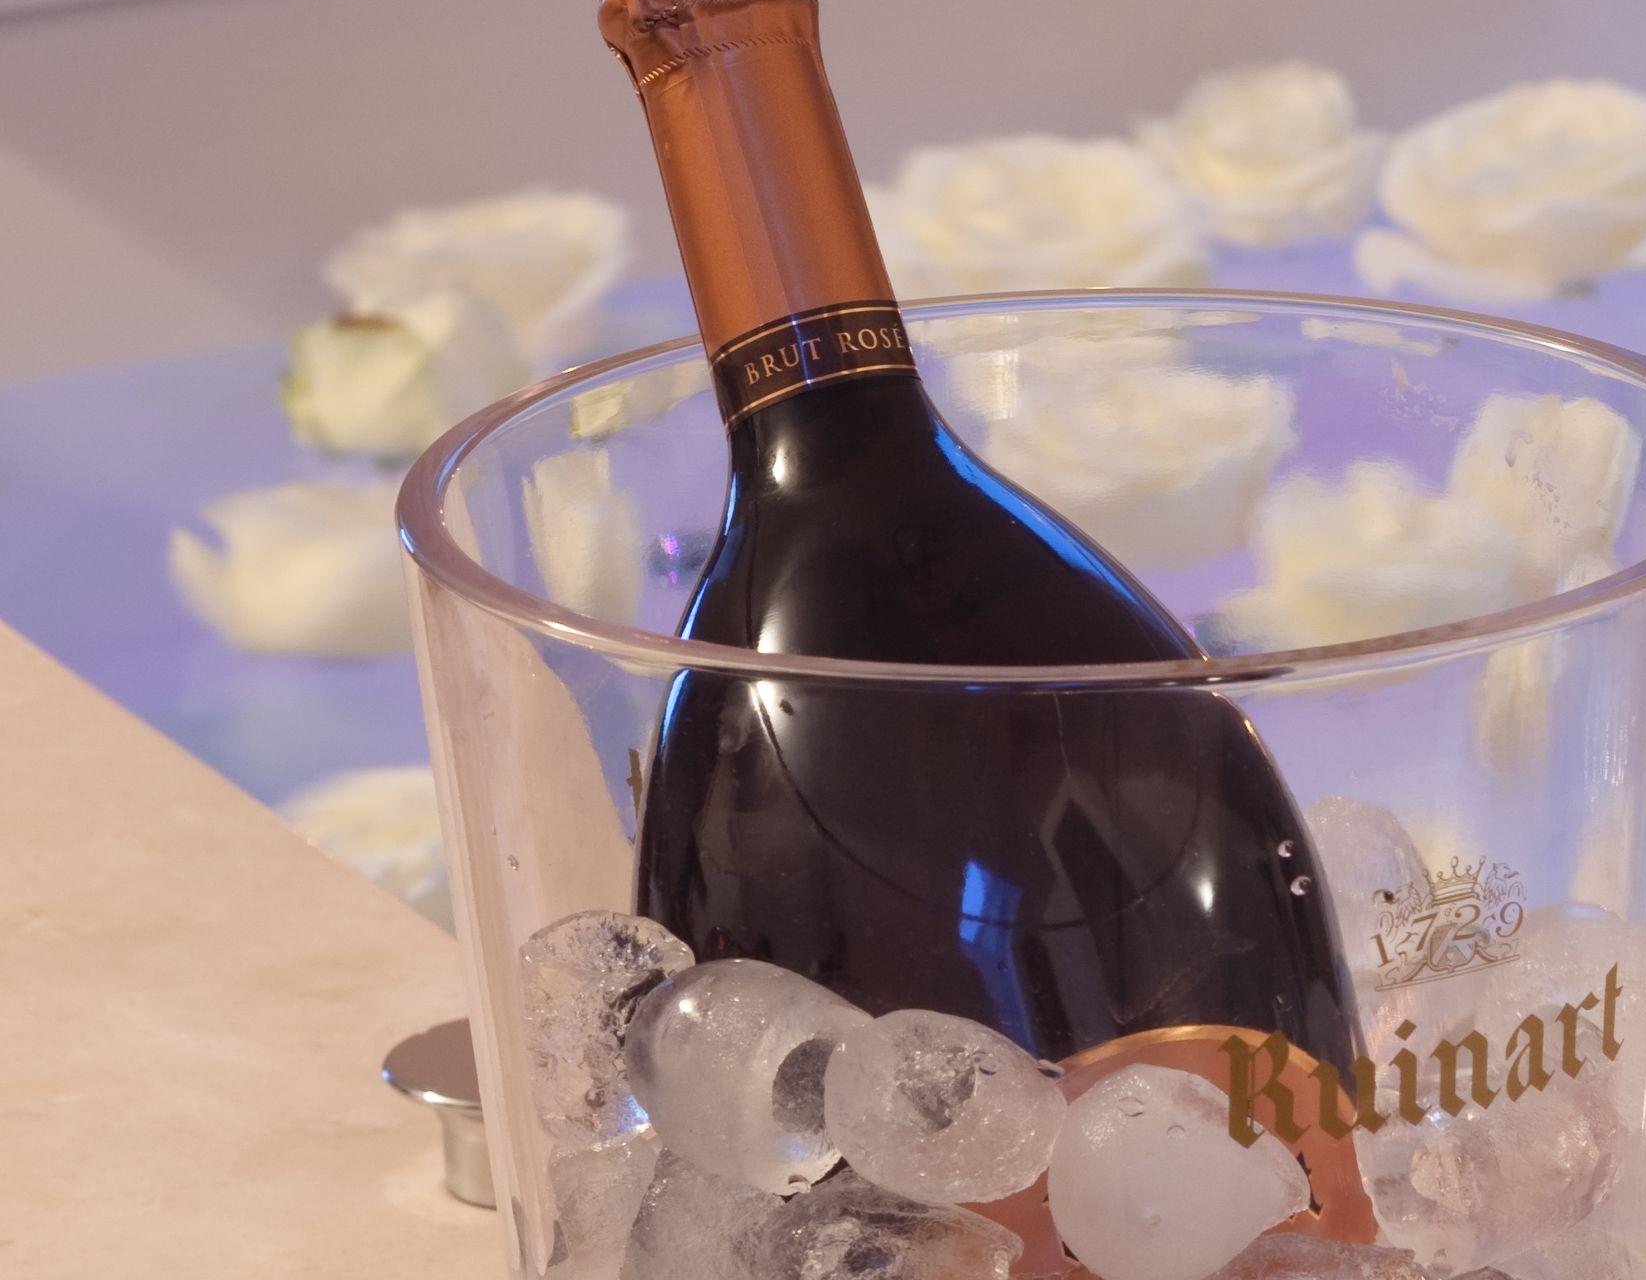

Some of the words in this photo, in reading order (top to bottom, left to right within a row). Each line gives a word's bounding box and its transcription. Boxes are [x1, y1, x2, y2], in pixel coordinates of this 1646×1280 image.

[744, 337, 822, 385] BRUT
[837, 323, 906, 354] ROSÉ
[1370, 901, 1524, 968] 1729
[1216, 962, 1624, 1149] Ruinart
